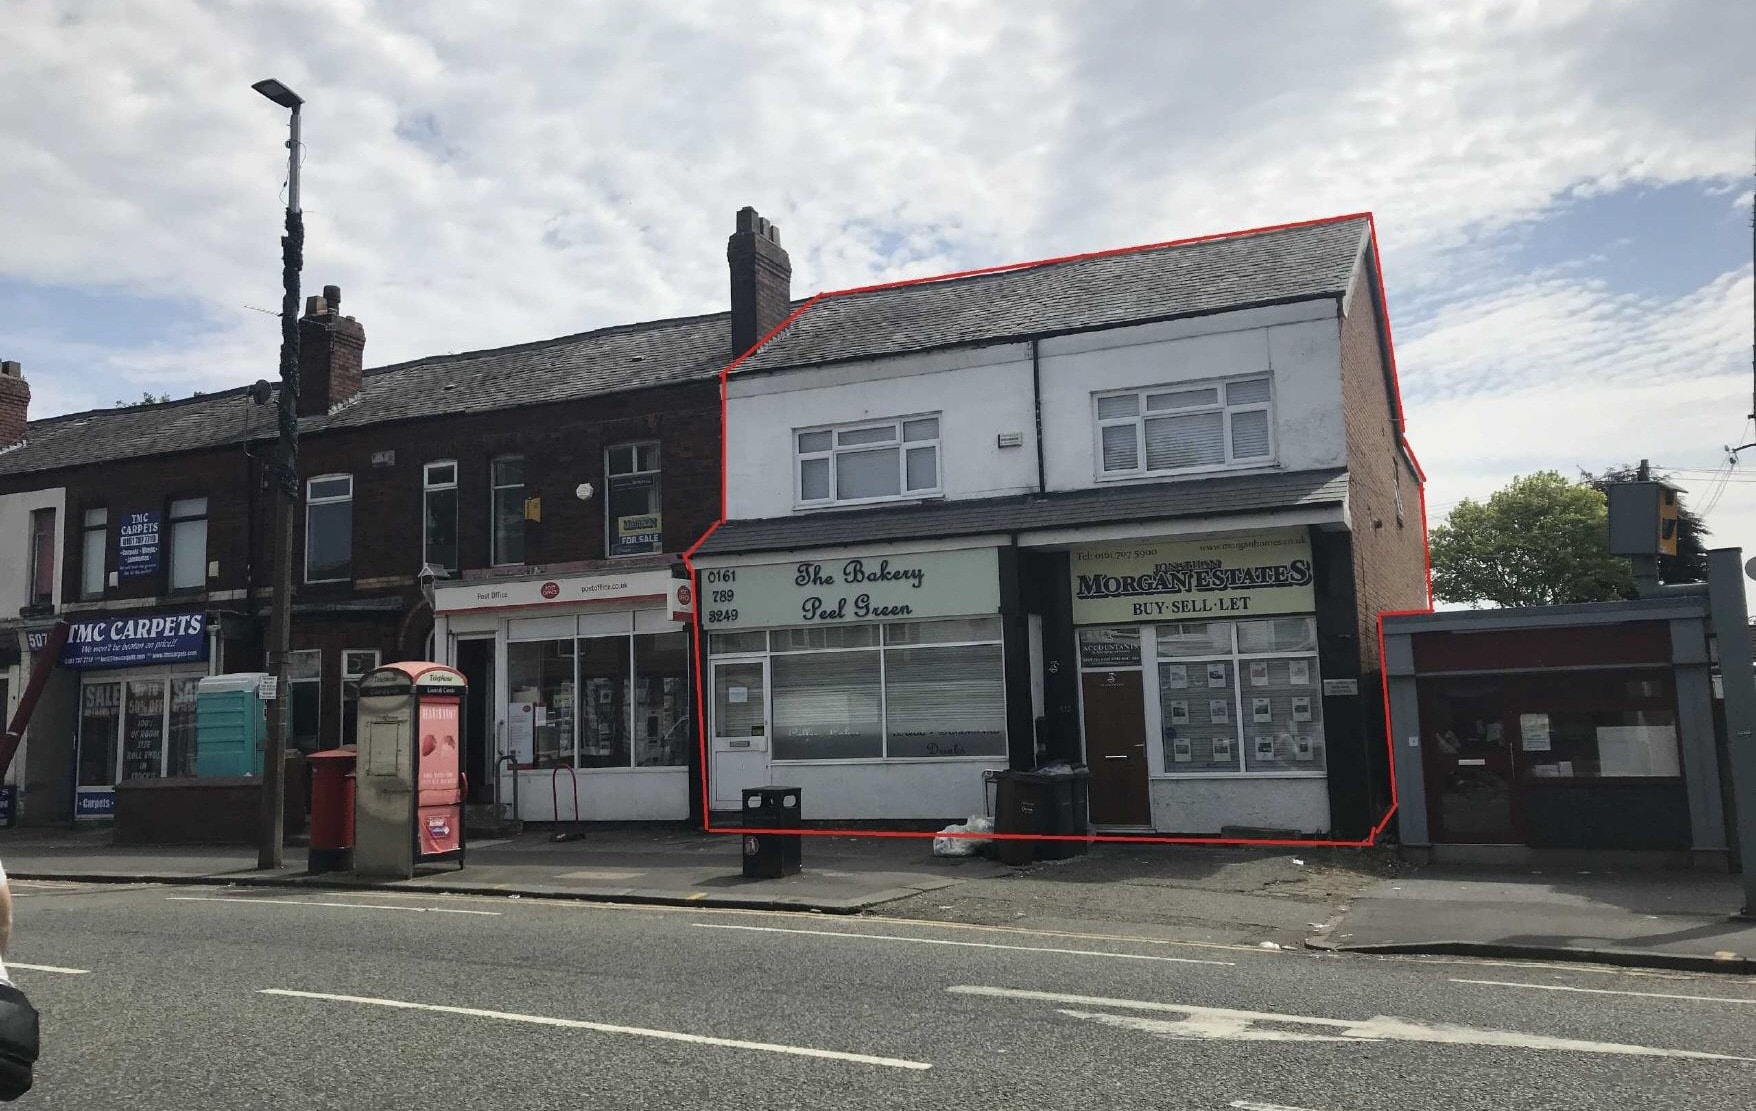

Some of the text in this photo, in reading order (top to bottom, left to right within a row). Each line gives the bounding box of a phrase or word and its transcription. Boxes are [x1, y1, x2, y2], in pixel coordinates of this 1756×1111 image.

[131, 513, 149, 523] TMC
[120, 523, 159, 535] CARPETS
[621, 534, 659, 544] FOR SALE
[1154, 560, 1222, 572] JONATHAN
[707, 569, 736, 583] 0161
[795, 559, 924, 588] The Bakery
[1076, 559, 1313, 599] MORGAN ESTATES
[477, 591, 508, 600] Post Office
[712, 589, 735, 603] 789
[802, 593, 913, 620] Peel Green
[709, 609, 738, 623] 3249
[66, 615, 203, 644] TMC CARPETS
[1083, 643, 1138, 652] ACCOUNTANTS
[85, 684, 120, 708] SALE
[83, 798, 110, 809] Carpets
